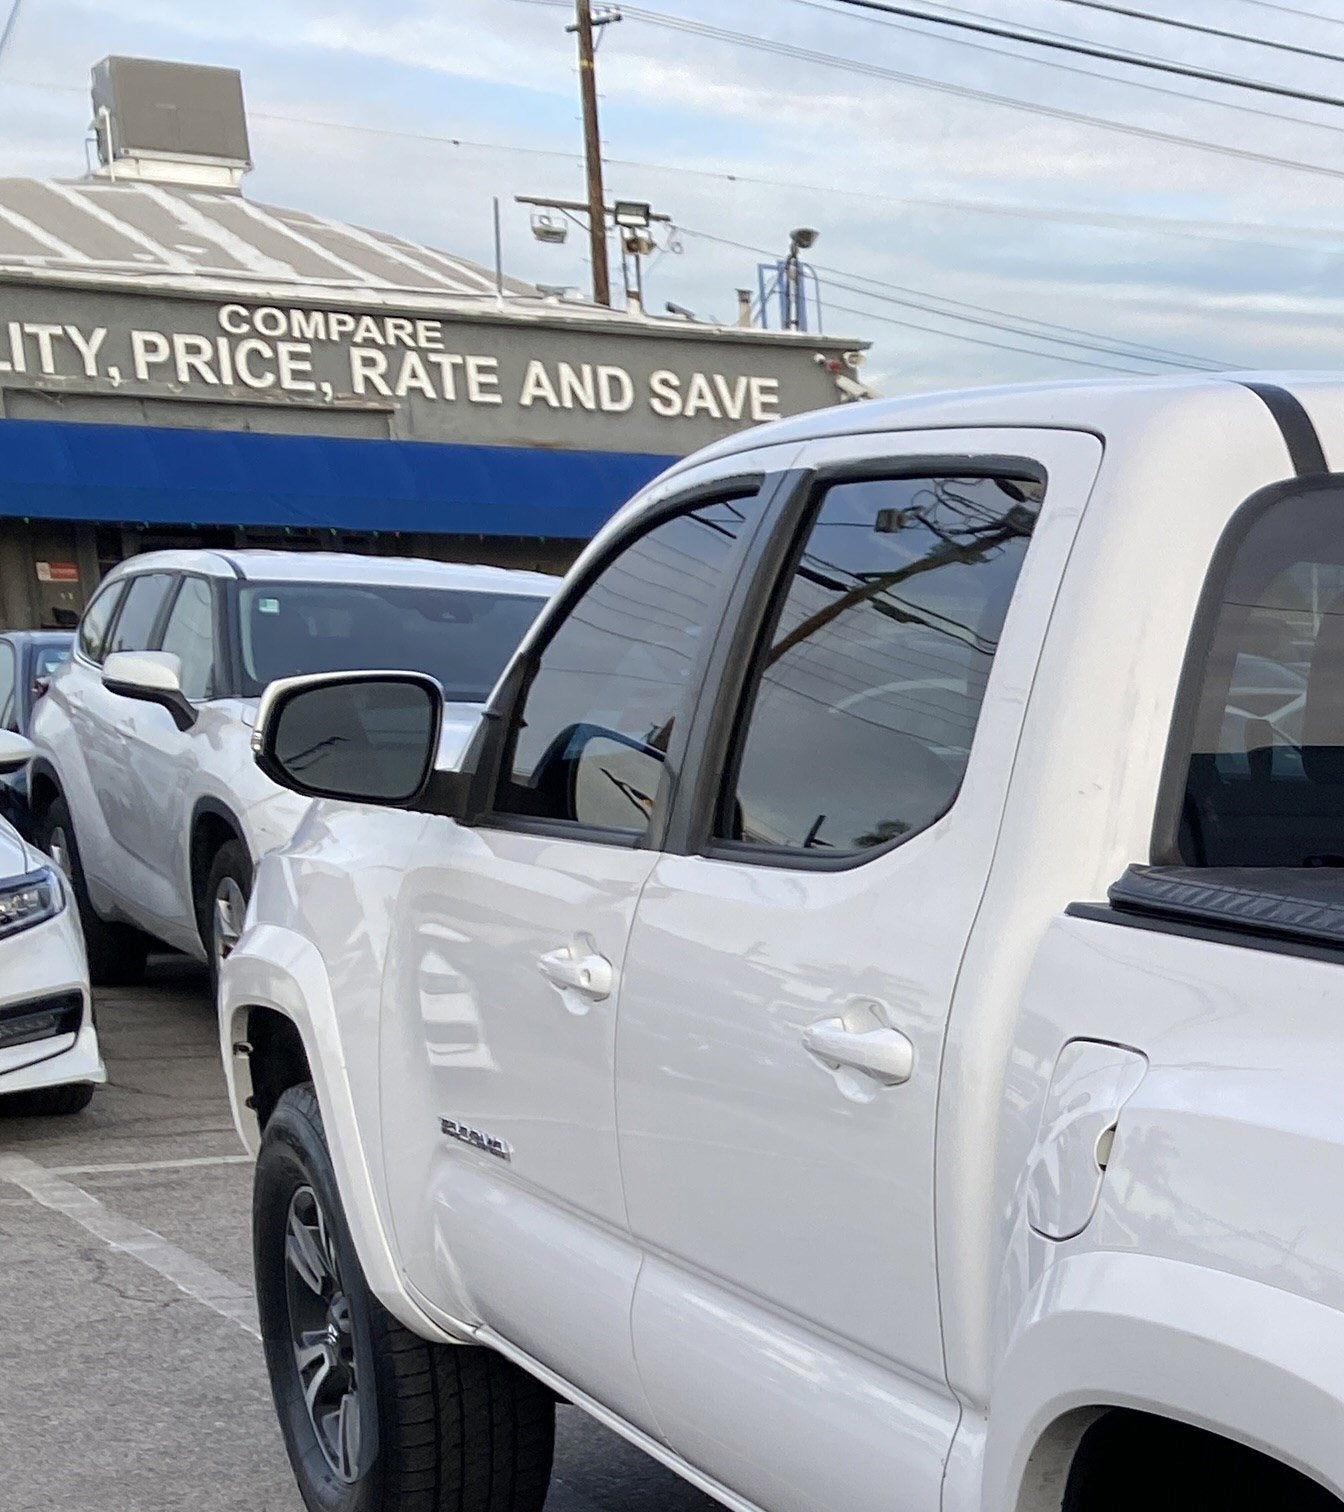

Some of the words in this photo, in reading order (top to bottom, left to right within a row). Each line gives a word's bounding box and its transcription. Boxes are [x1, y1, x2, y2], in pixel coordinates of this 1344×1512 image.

[217, 303, 444, 350] COMPARE
[0, 321, 121, 388] ITY,
[130, 330, 333, 402] PRICE,
[350, 345, 503, 404] RATE
[519, 361, 635, 413] AND
[648, 370, 781, 422] SAVE
